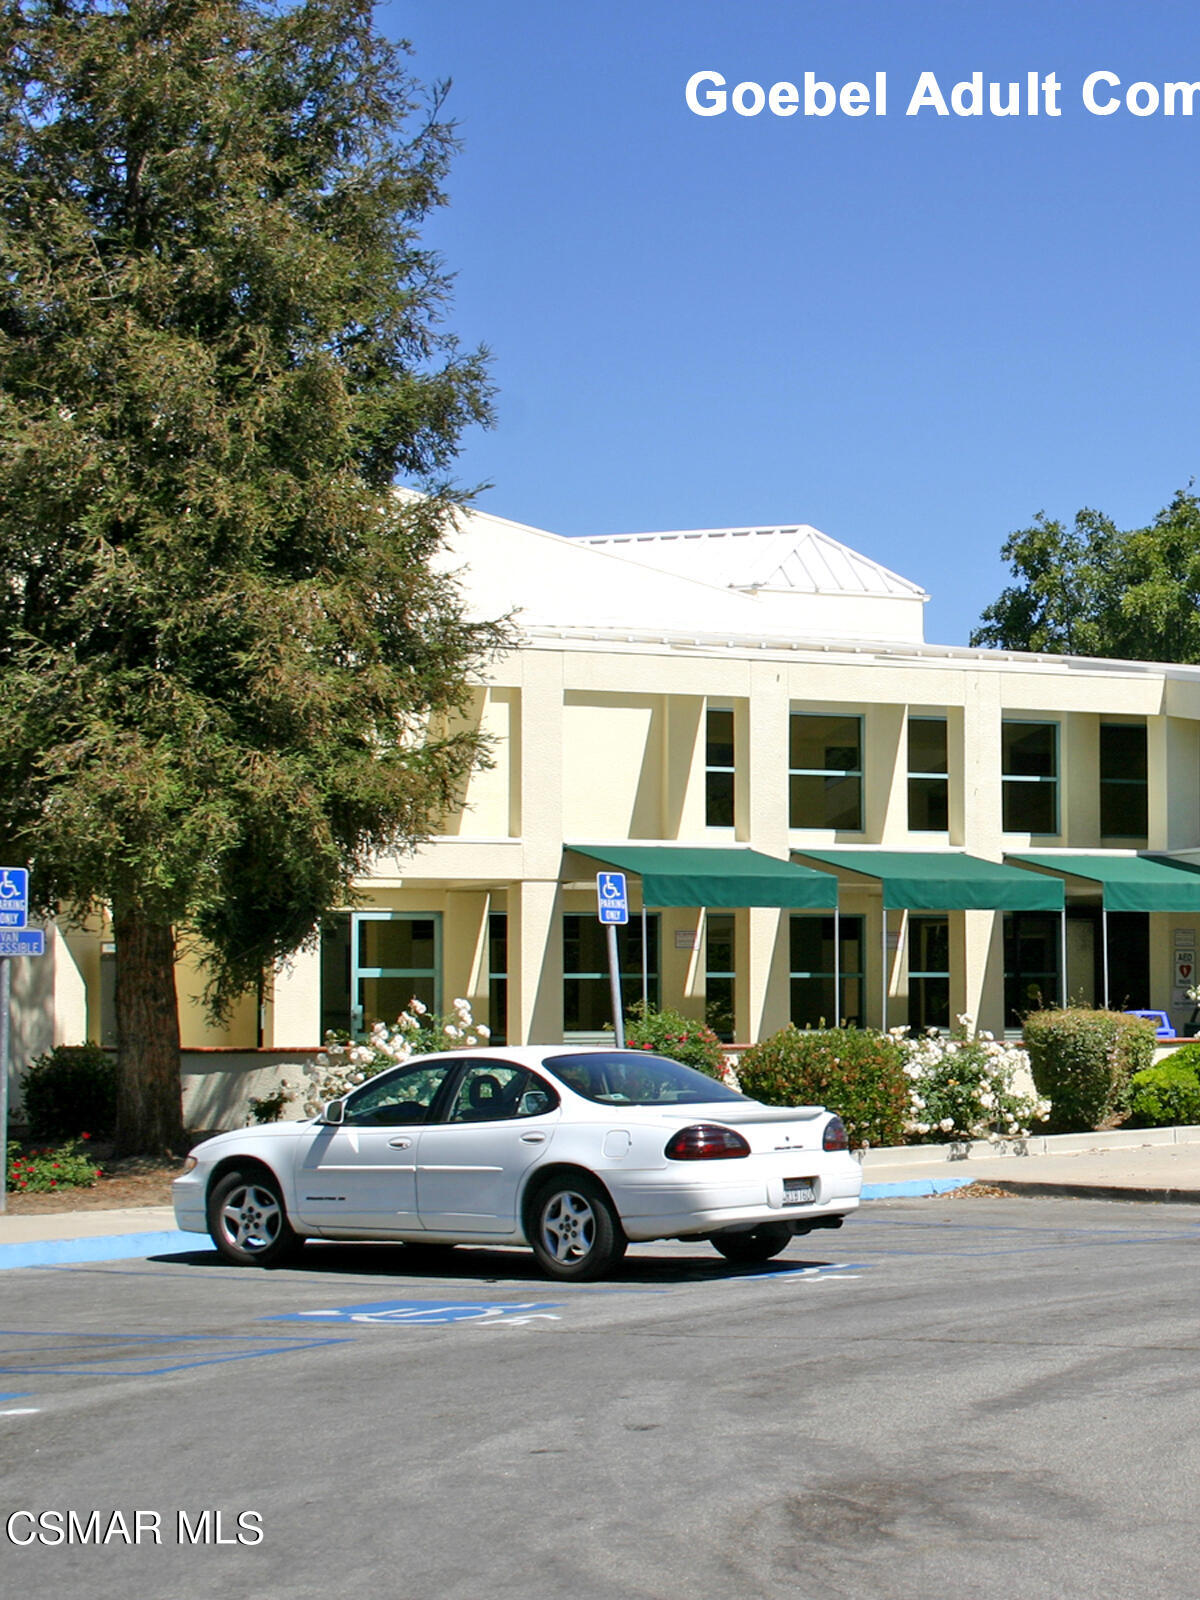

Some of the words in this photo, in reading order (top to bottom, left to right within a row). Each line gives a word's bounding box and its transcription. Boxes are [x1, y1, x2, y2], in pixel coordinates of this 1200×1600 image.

[0, 899, 25, 911] ARKING
[600, 899, 625, 909] PARKING
[605, 910, 621, 920] ONLY
[1, 932, 19, 942] VAN
[0, 942, 40, 953] ESSIBLE
